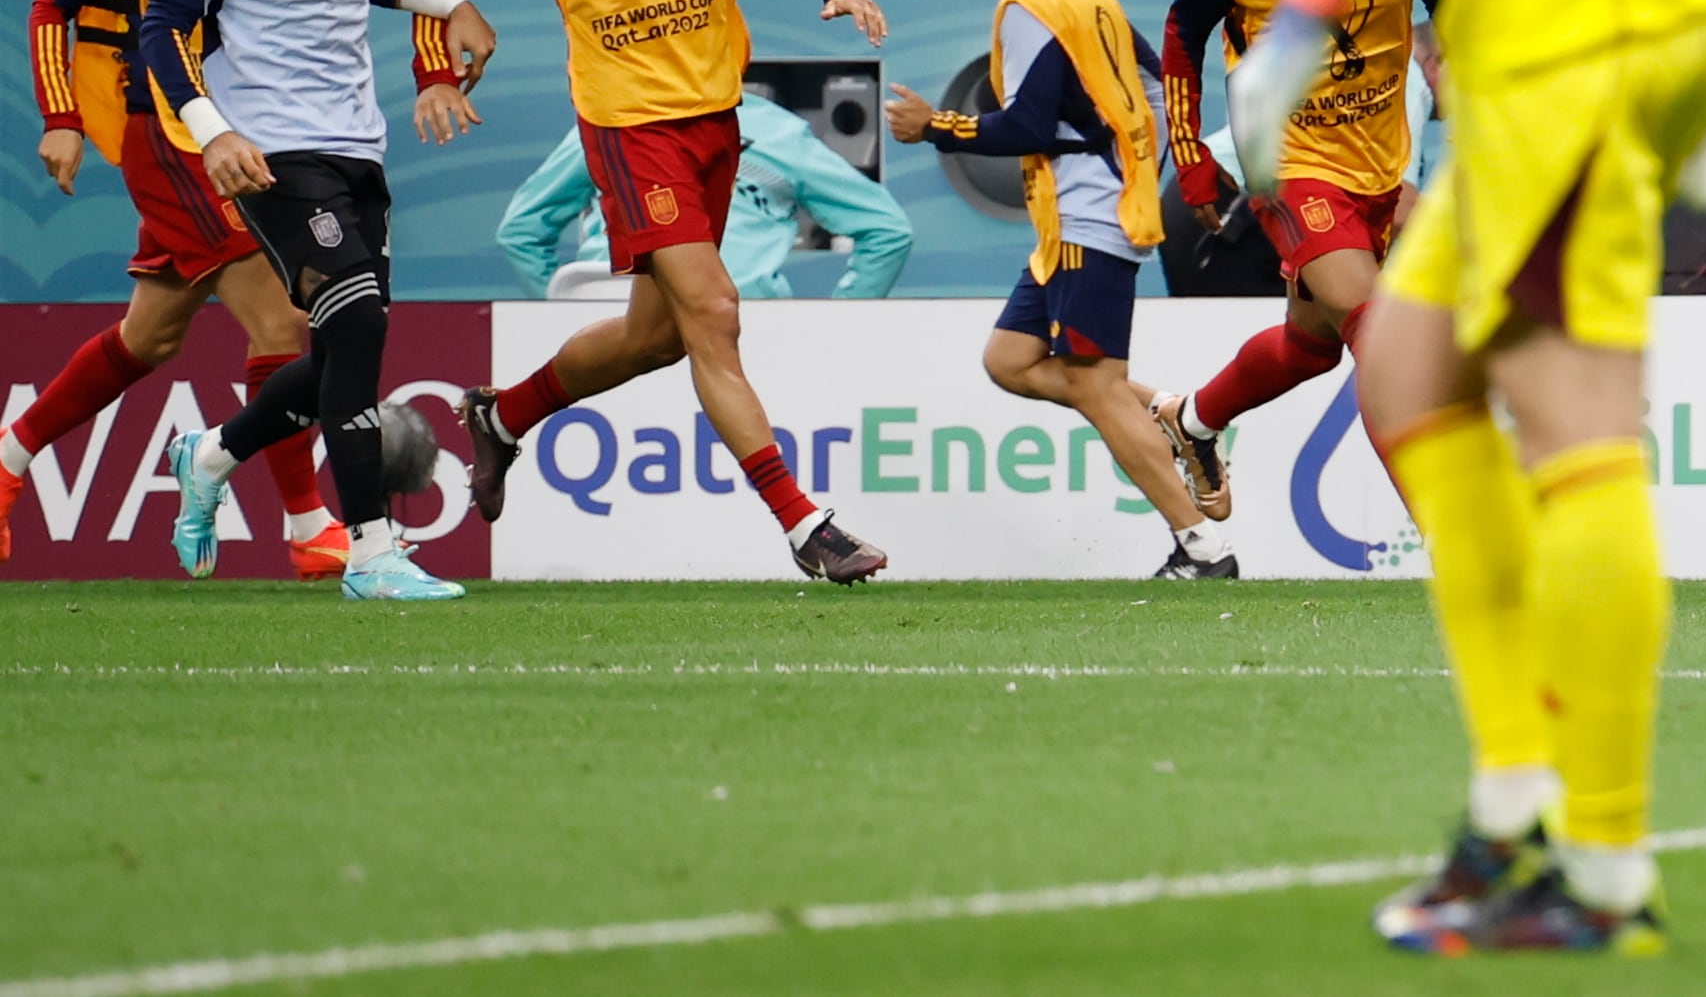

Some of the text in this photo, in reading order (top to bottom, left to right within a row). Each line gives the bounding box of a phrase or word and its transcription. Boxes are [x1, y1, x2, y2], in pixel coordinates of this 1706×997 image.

[591, 14, 627, 34] FIFA
[627, 0, 687, 24] WORLD
[1318, 87, 1377, 110] WORLD
[1378, 74, 1399, 95] CUP
